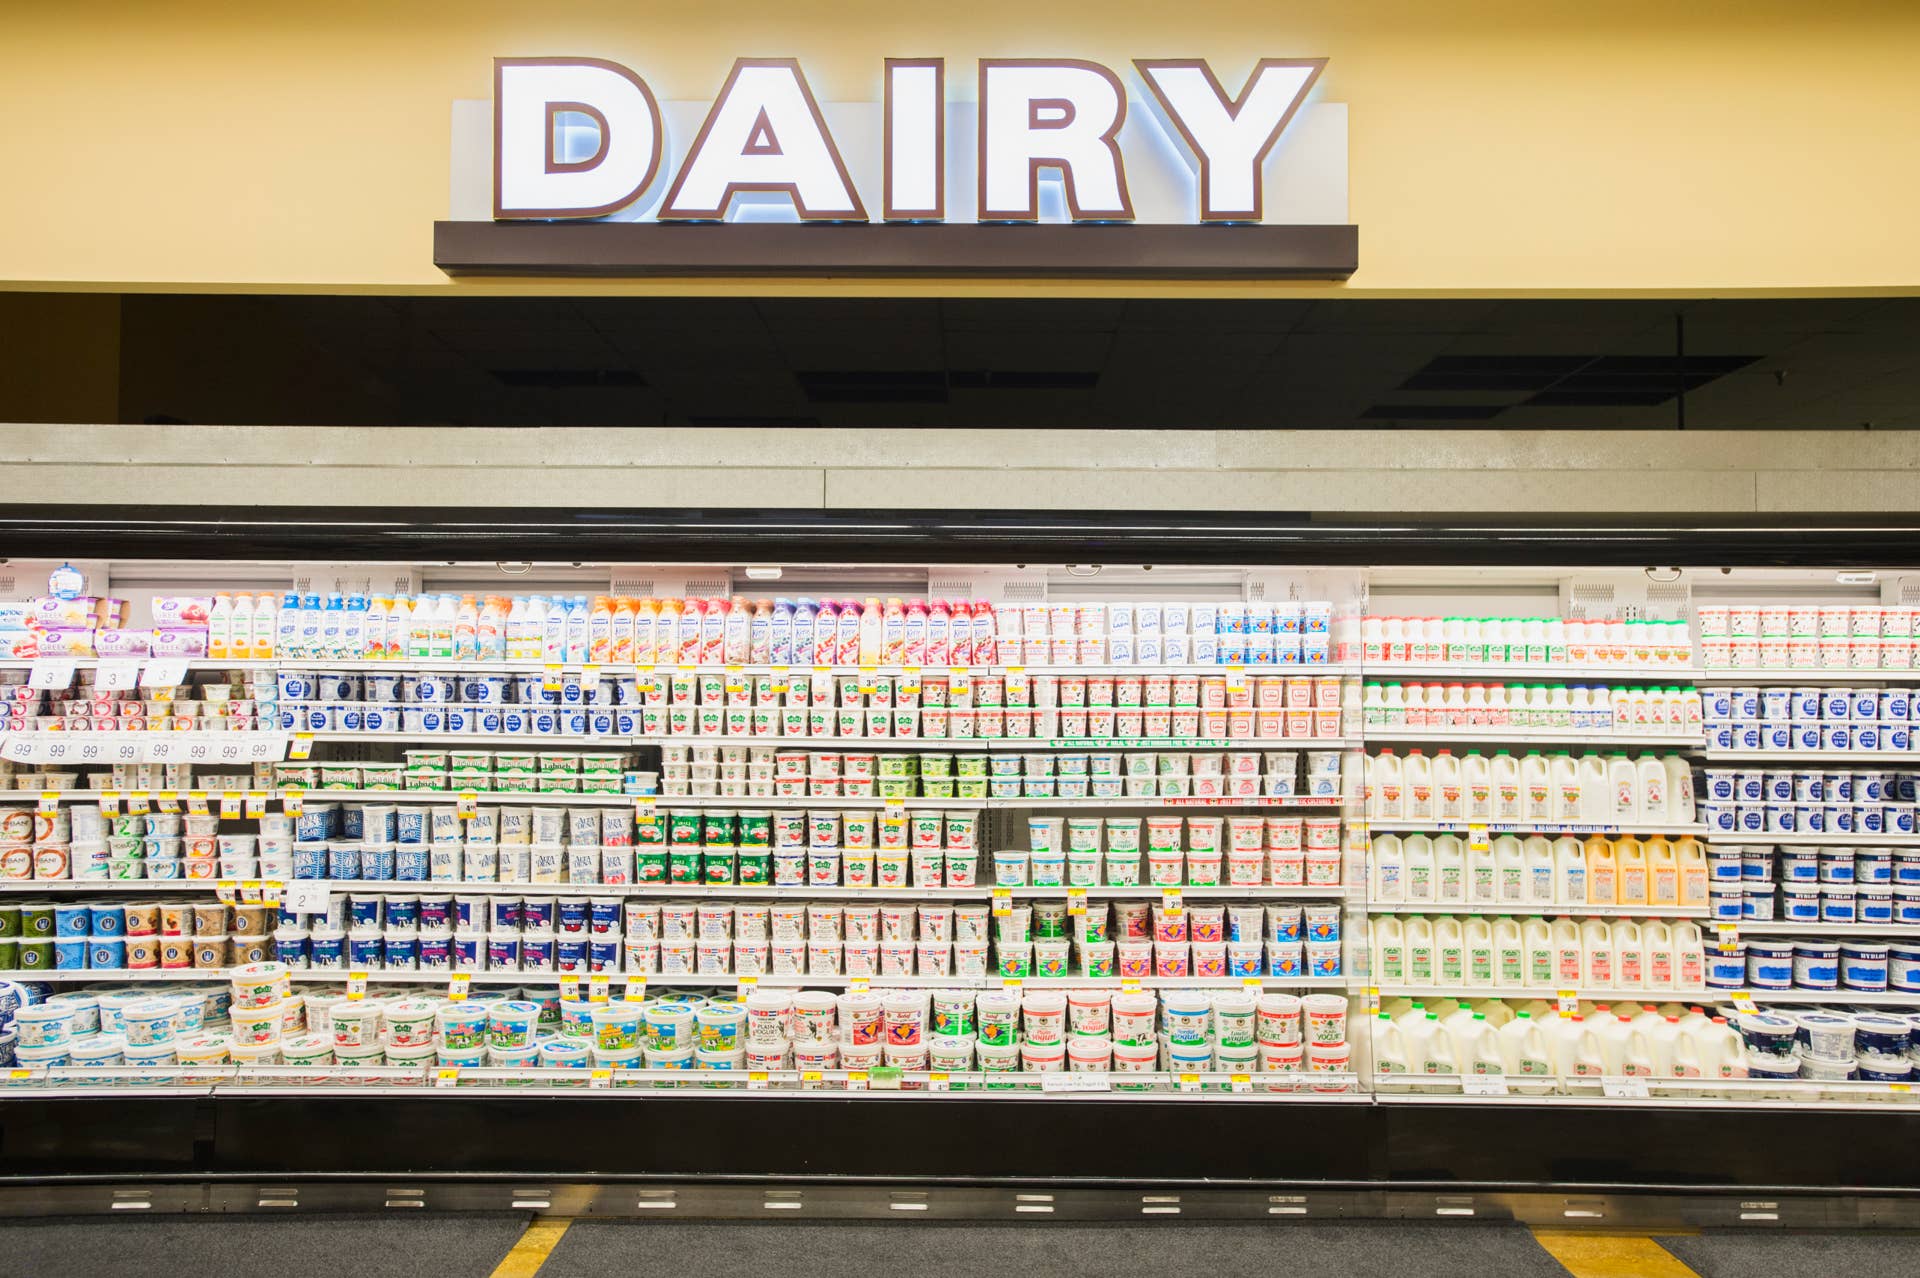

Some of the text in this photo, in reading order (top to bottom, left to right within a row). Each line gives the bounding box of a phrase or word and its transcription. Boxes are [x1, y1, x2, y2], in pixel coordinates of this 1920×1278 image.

[493, 57, 1330, 223] DAIRY
[109, 673, 116, 685] 3
[14, 744, 31, 756] 99
[50, 745, 65, 757] 99
[83, 746, 98, 758] 99
[120, 746, 134, 758] 99
[153, 744, 168, 756] 99
[191, 746, 205, 758] 99
[223, 746, 237, 758] 99
[252, 744, 266, 756] 99
[298, 895, 306, 907] 2
